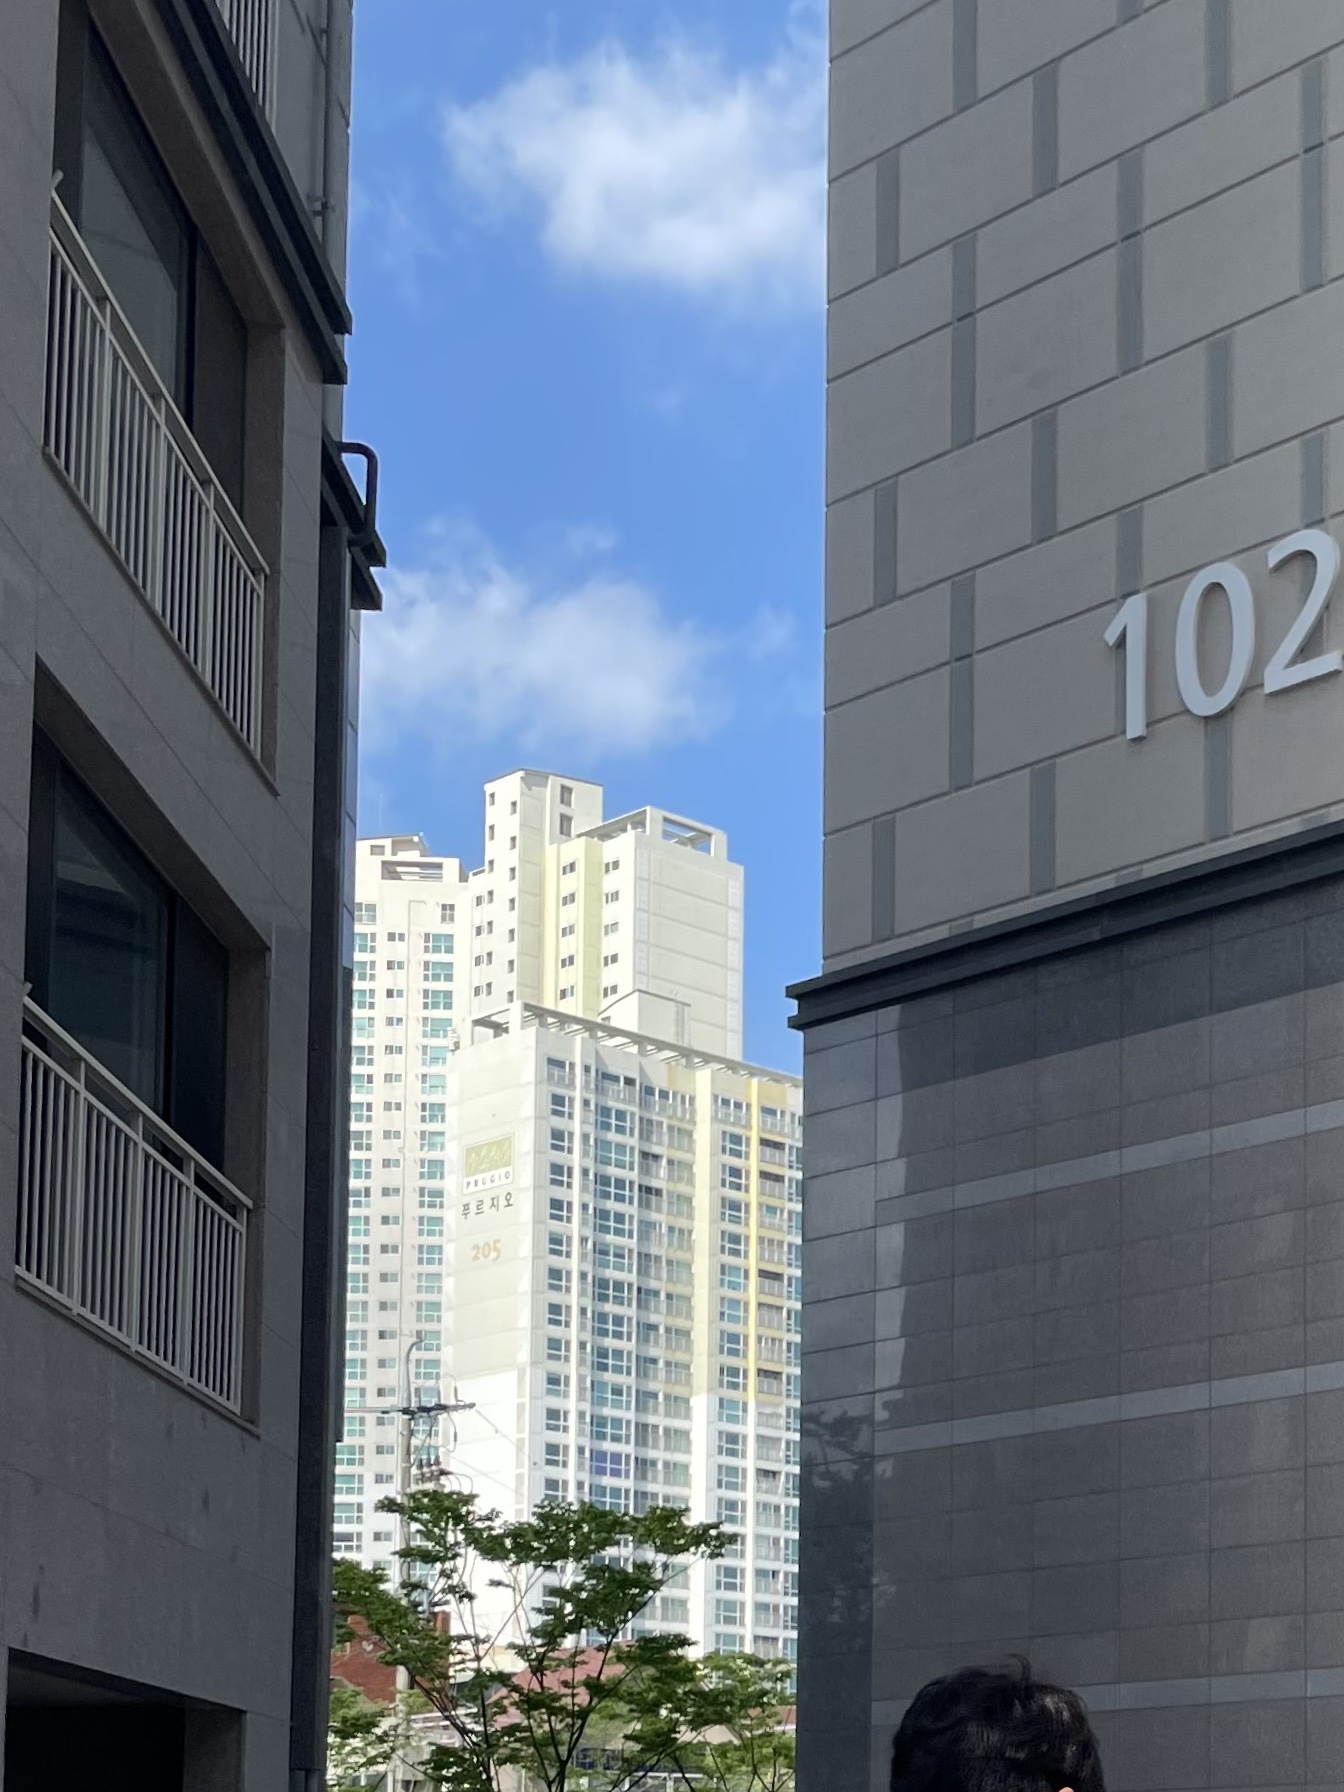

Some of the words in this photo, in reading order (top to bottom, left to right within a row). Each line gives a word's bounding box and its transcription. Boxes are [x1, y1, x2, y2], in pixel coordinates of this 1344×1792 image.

[1103, 528, 1343, 741] 102
[465, 1170, 511, 1190] PRUGIO
[461, 1191, 514, 1220] 푸르지오
[471, 1238, 502, 1263] 205
